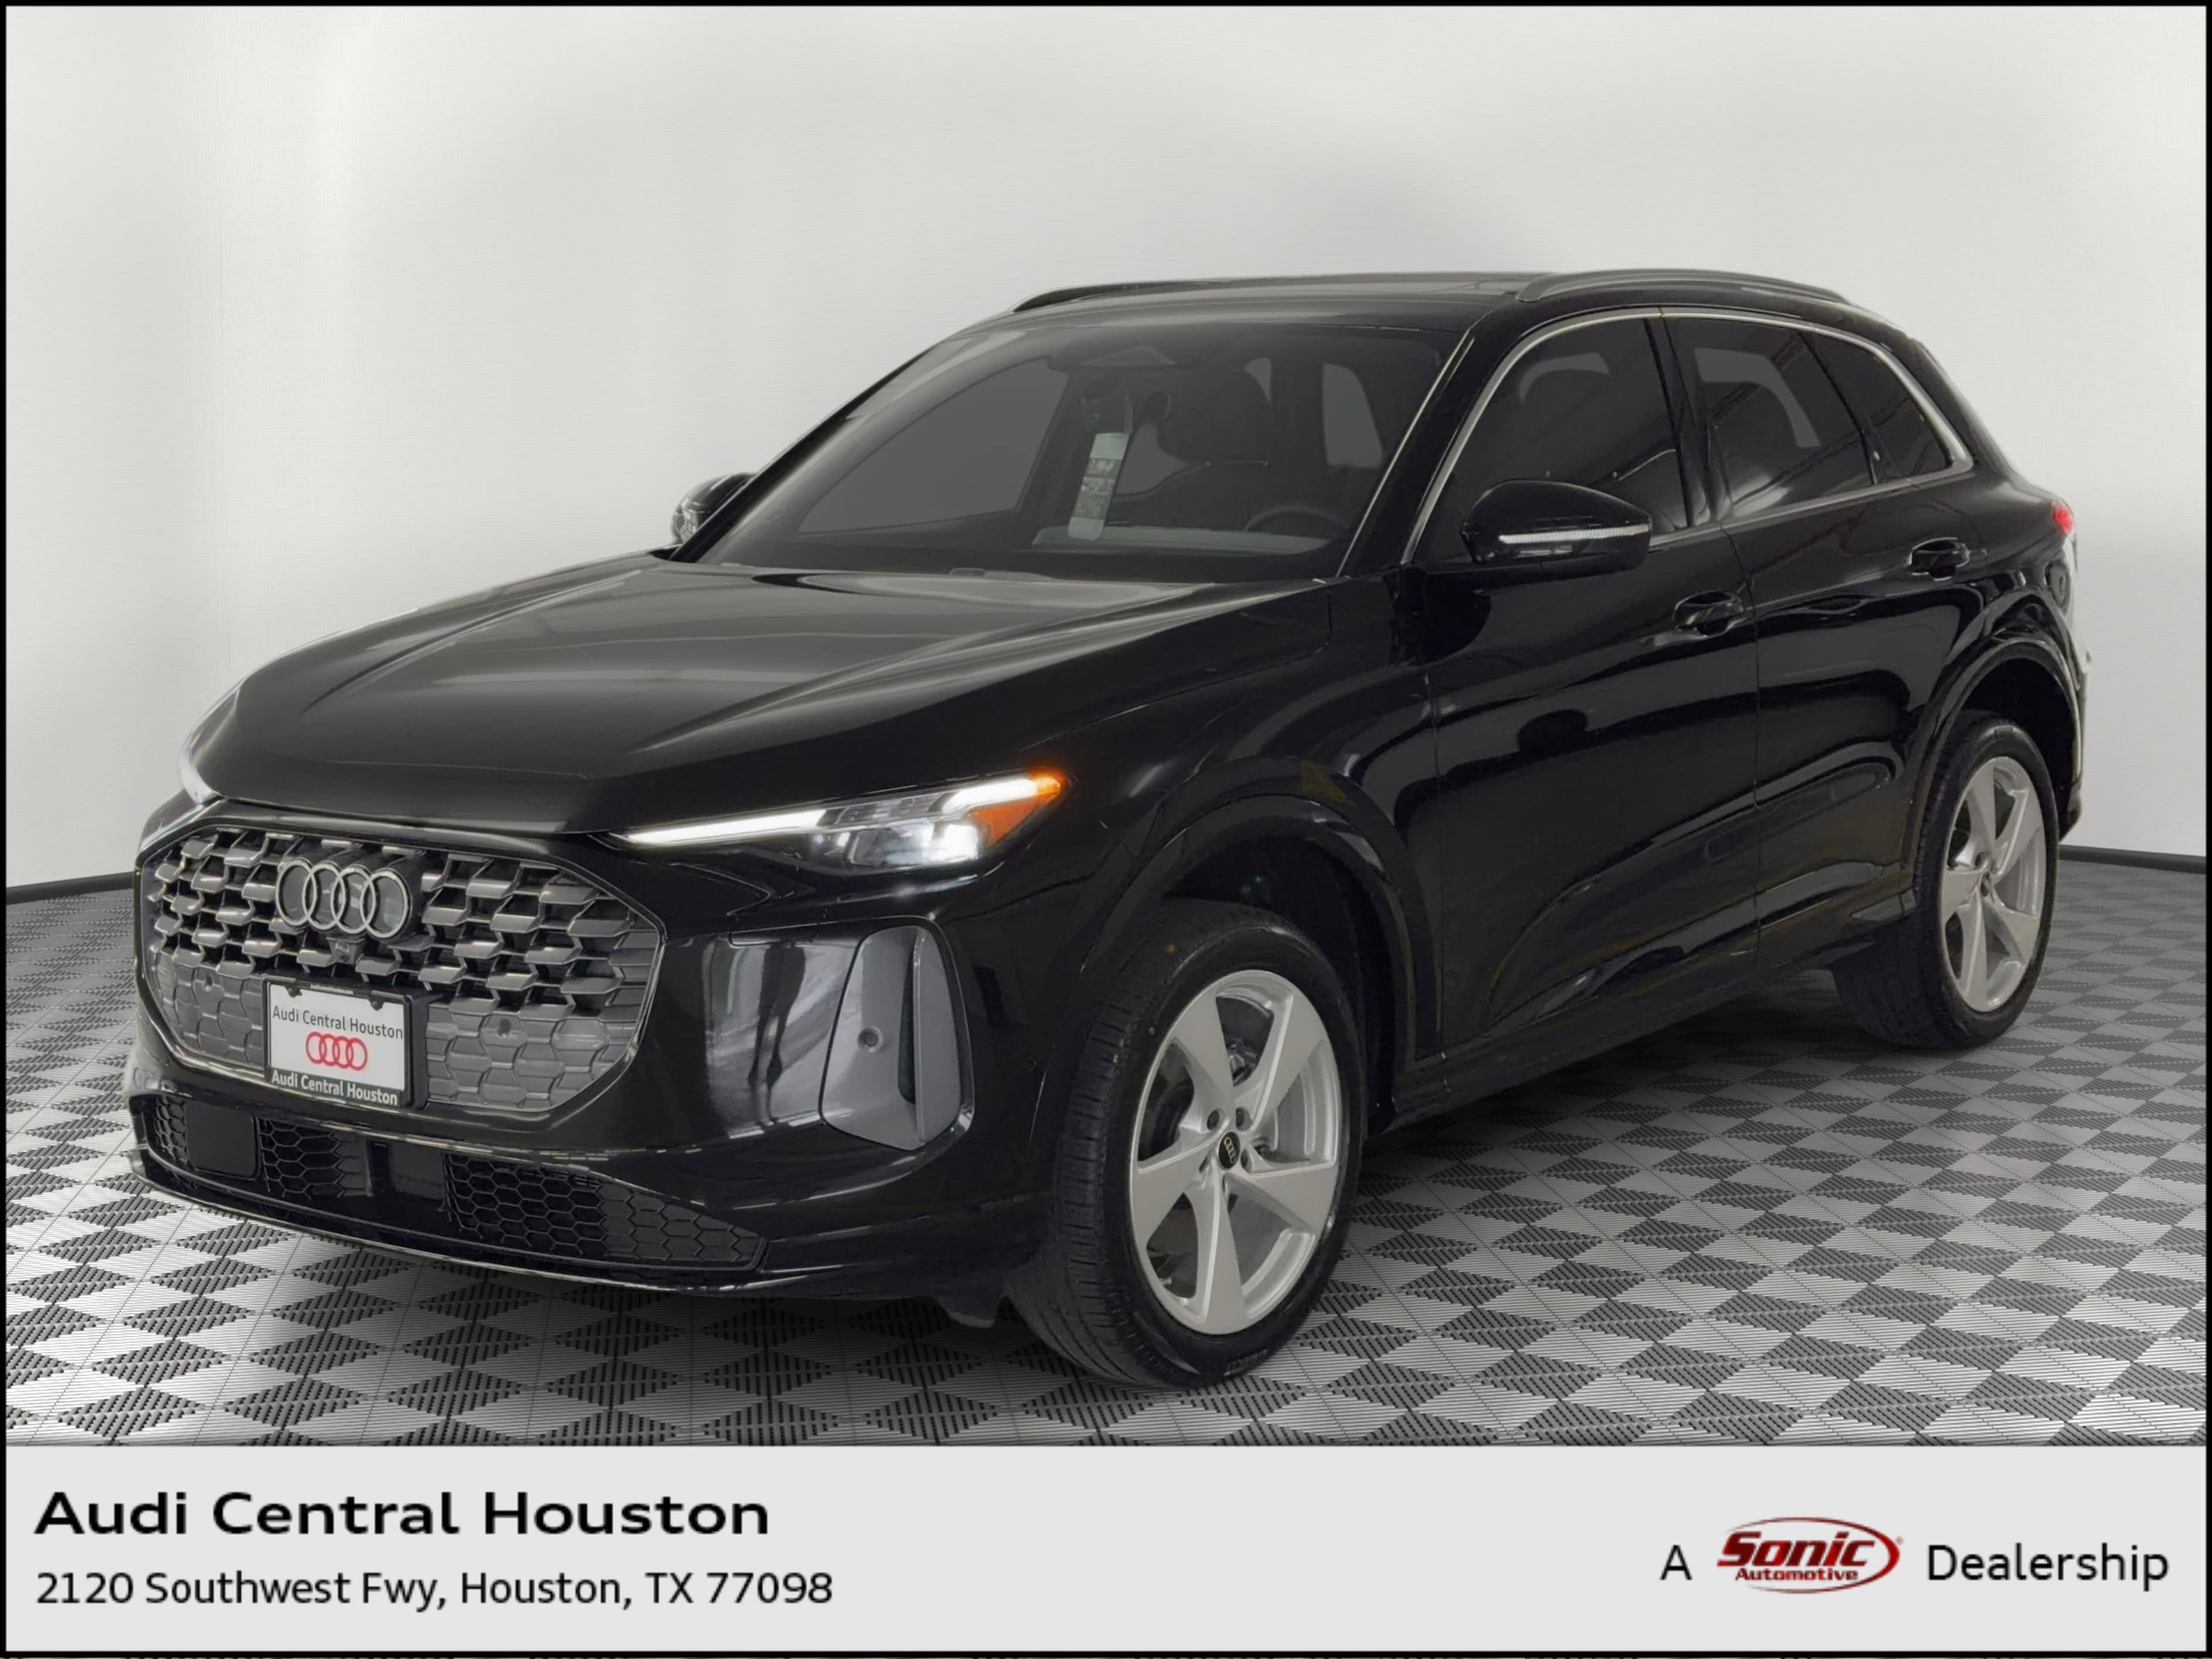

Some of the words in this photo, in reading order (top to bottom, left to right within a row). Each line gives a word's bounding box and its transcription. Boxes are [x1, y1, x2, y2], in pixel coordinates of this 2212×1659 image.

[273, 1005, 299, 1023] Audi
[303, 1010, 346, 1031] Central
[349, 1018, 403, 1040] Houston
[272, 1070, 298, 1087] Audi
[301, 1075, 344, 1096] Central
[347, 1082, 398, 1105] Houston
